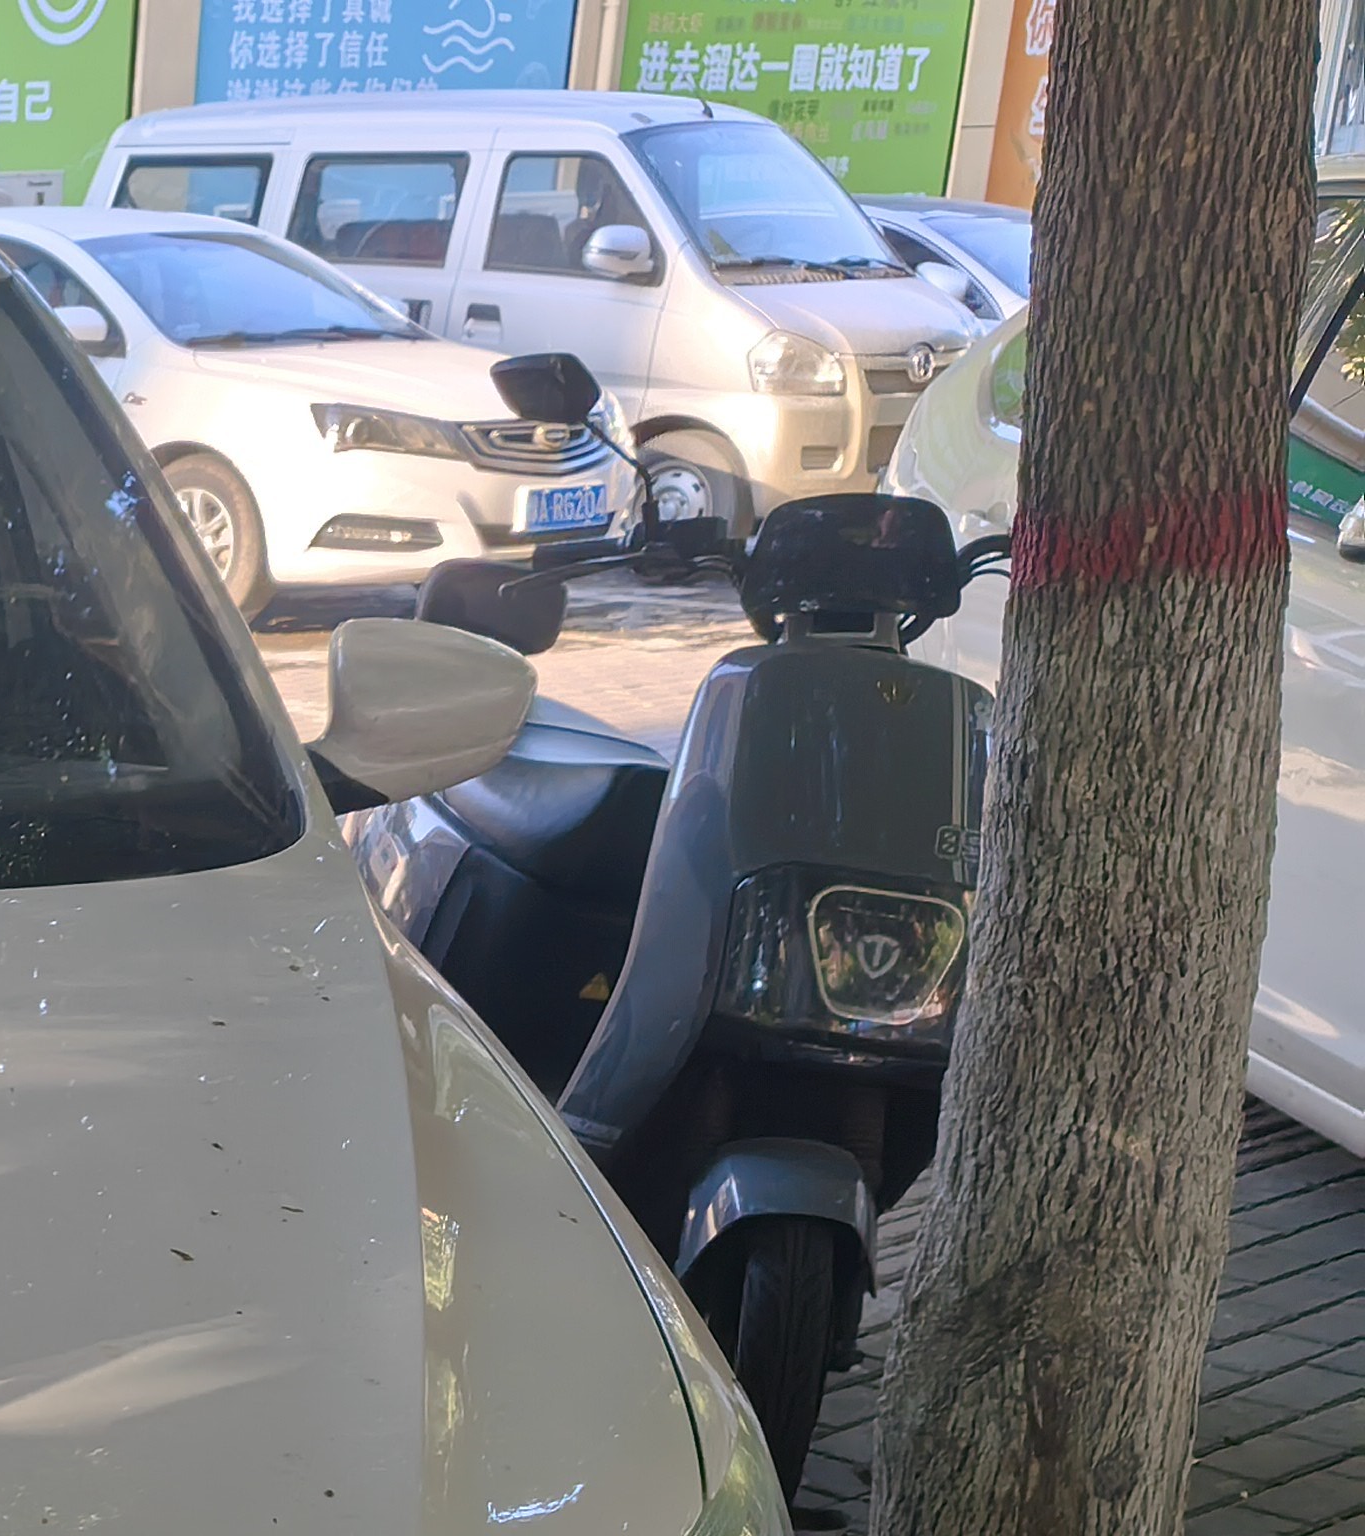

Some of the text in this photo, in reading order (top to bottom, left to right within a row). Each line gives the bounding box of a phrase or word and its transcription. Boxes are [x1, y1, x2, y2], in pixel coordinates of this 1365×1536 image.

[228, 30, 389, 69] 你选择了信任
[636, 40, 931, 92] 进去溜达一圈就知道了
